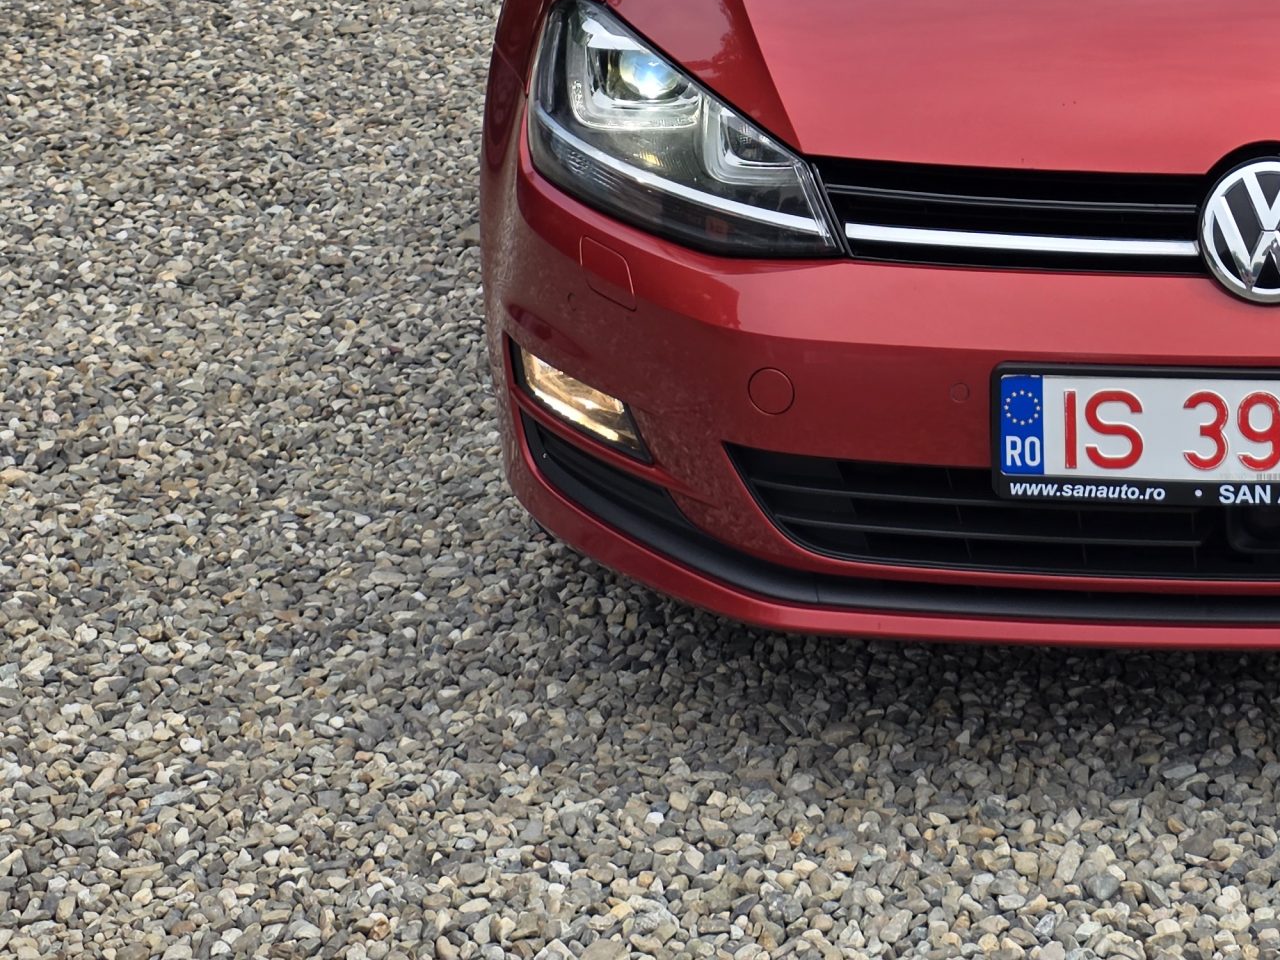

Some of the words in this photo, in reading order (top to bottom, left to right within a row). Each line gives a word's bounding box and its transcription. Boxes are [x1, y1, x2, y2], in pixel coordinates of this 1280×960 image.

[1063, 390, 1143, 470] IS
[1005, 435, 1041, 467] RO
[1009, 482, 1166, 501] www.sanauto.ro
[1218, 485, 1271, 504] SAN
